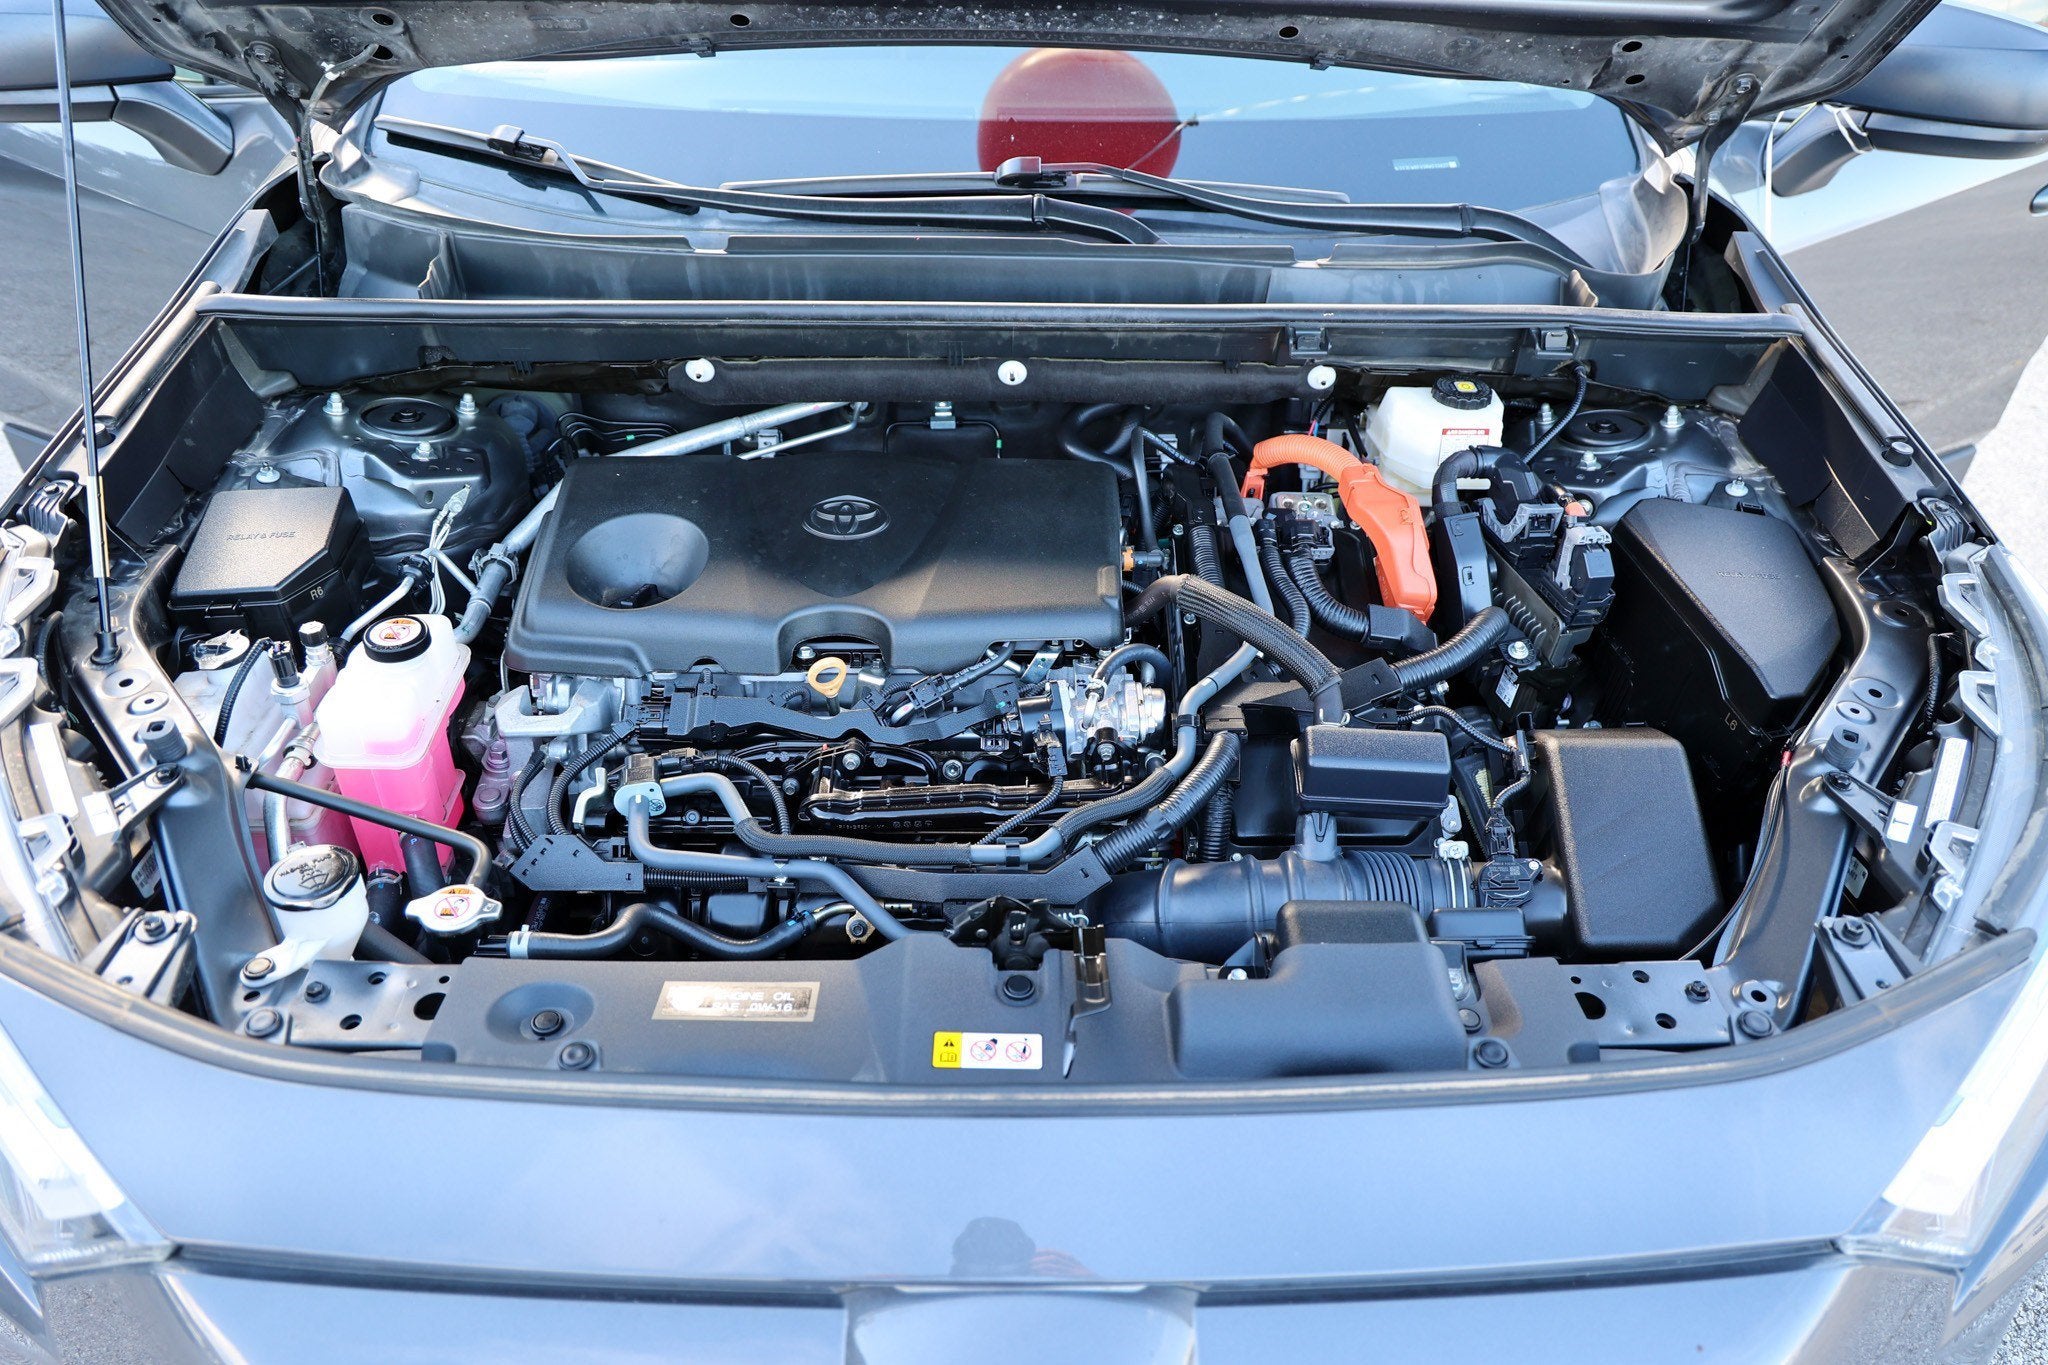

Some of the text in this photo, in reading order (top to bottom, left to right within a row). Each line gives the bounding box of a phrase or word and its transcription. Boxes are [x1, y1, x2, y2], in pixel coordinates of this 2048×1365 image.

[226, 533, 260, 541] RELAY
[269, 531, 296, 539] FUSE
[310, 586, 324, 600] R6
[1725, 712, 1738, 731] L6
[773, 991, 796, 1001] OIL
